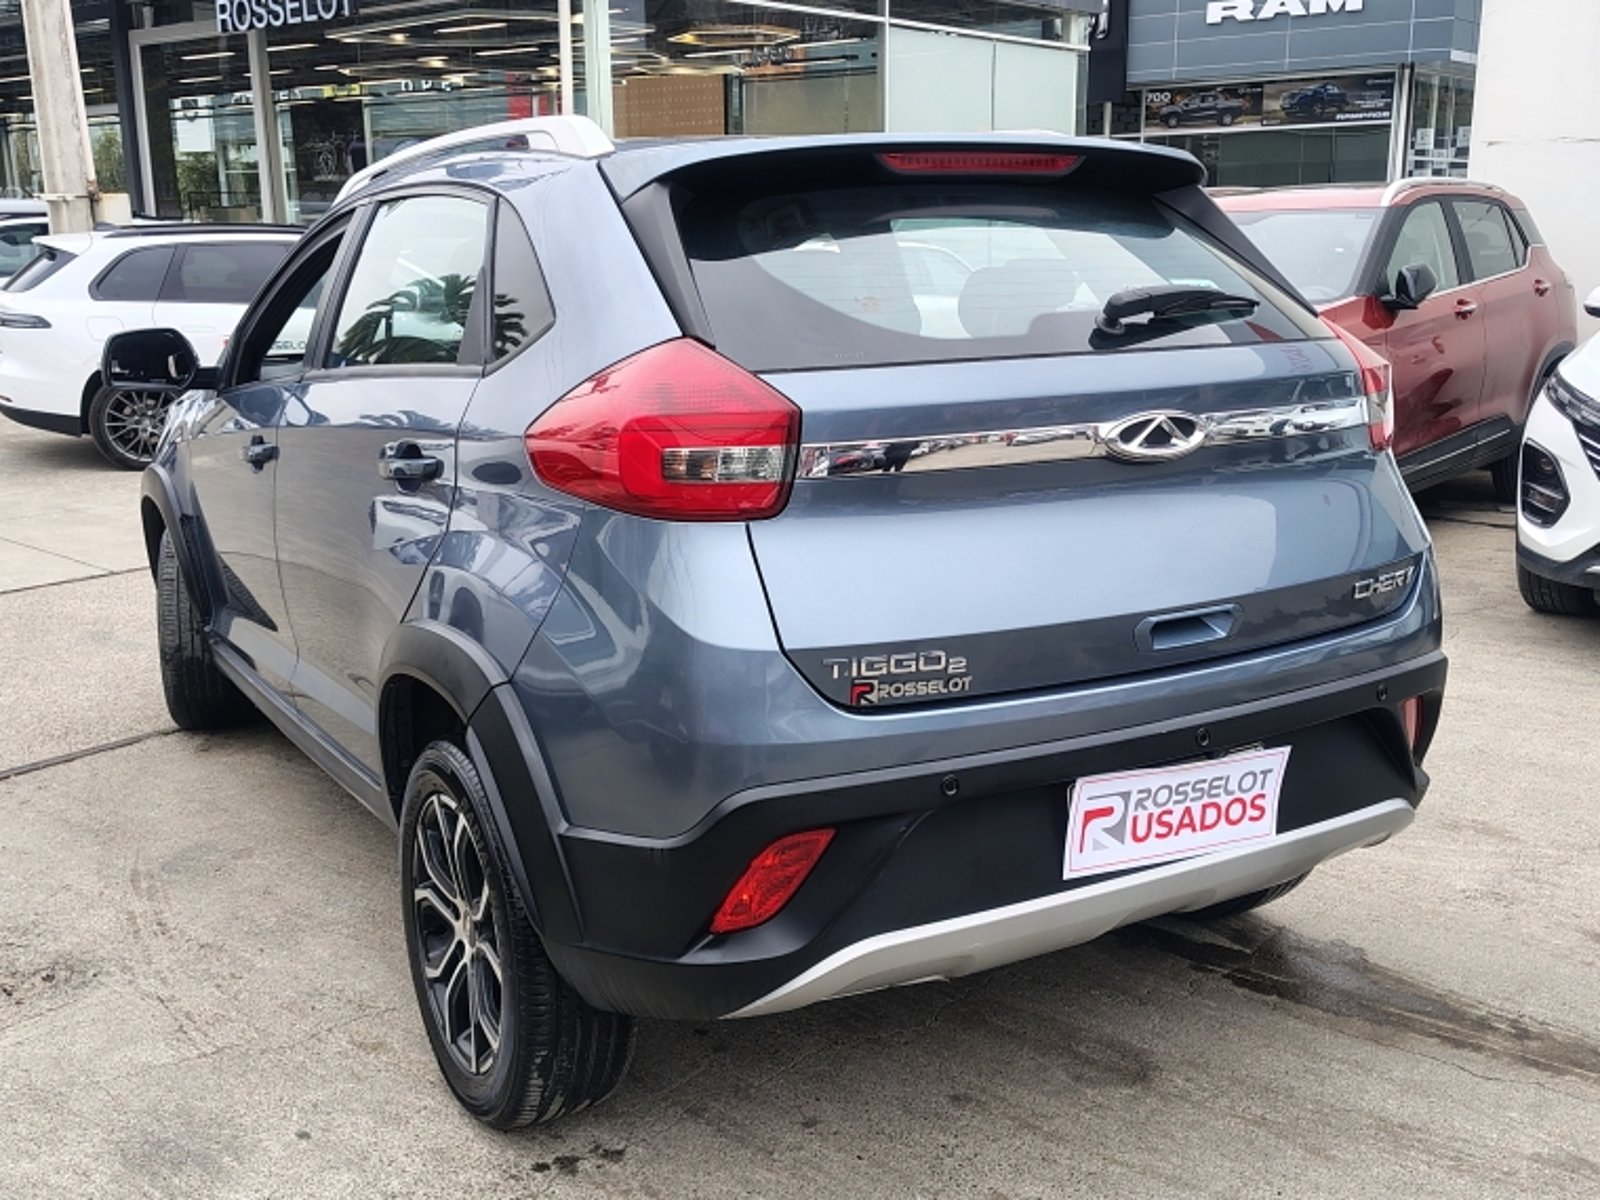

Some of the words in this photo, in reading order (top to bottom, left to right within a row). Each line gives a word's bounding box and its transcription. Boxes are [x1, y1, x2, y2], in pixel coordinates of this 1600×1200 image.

[1206, 0, 1363, 24] RAM
[1354, 566, 1415, 598] CHERY
[879, 676, 973, 698] ROSSELOT
[1134, 768, 1273, 811] ROSSELOT
[1130, 794, 1266, 843] USADOS
